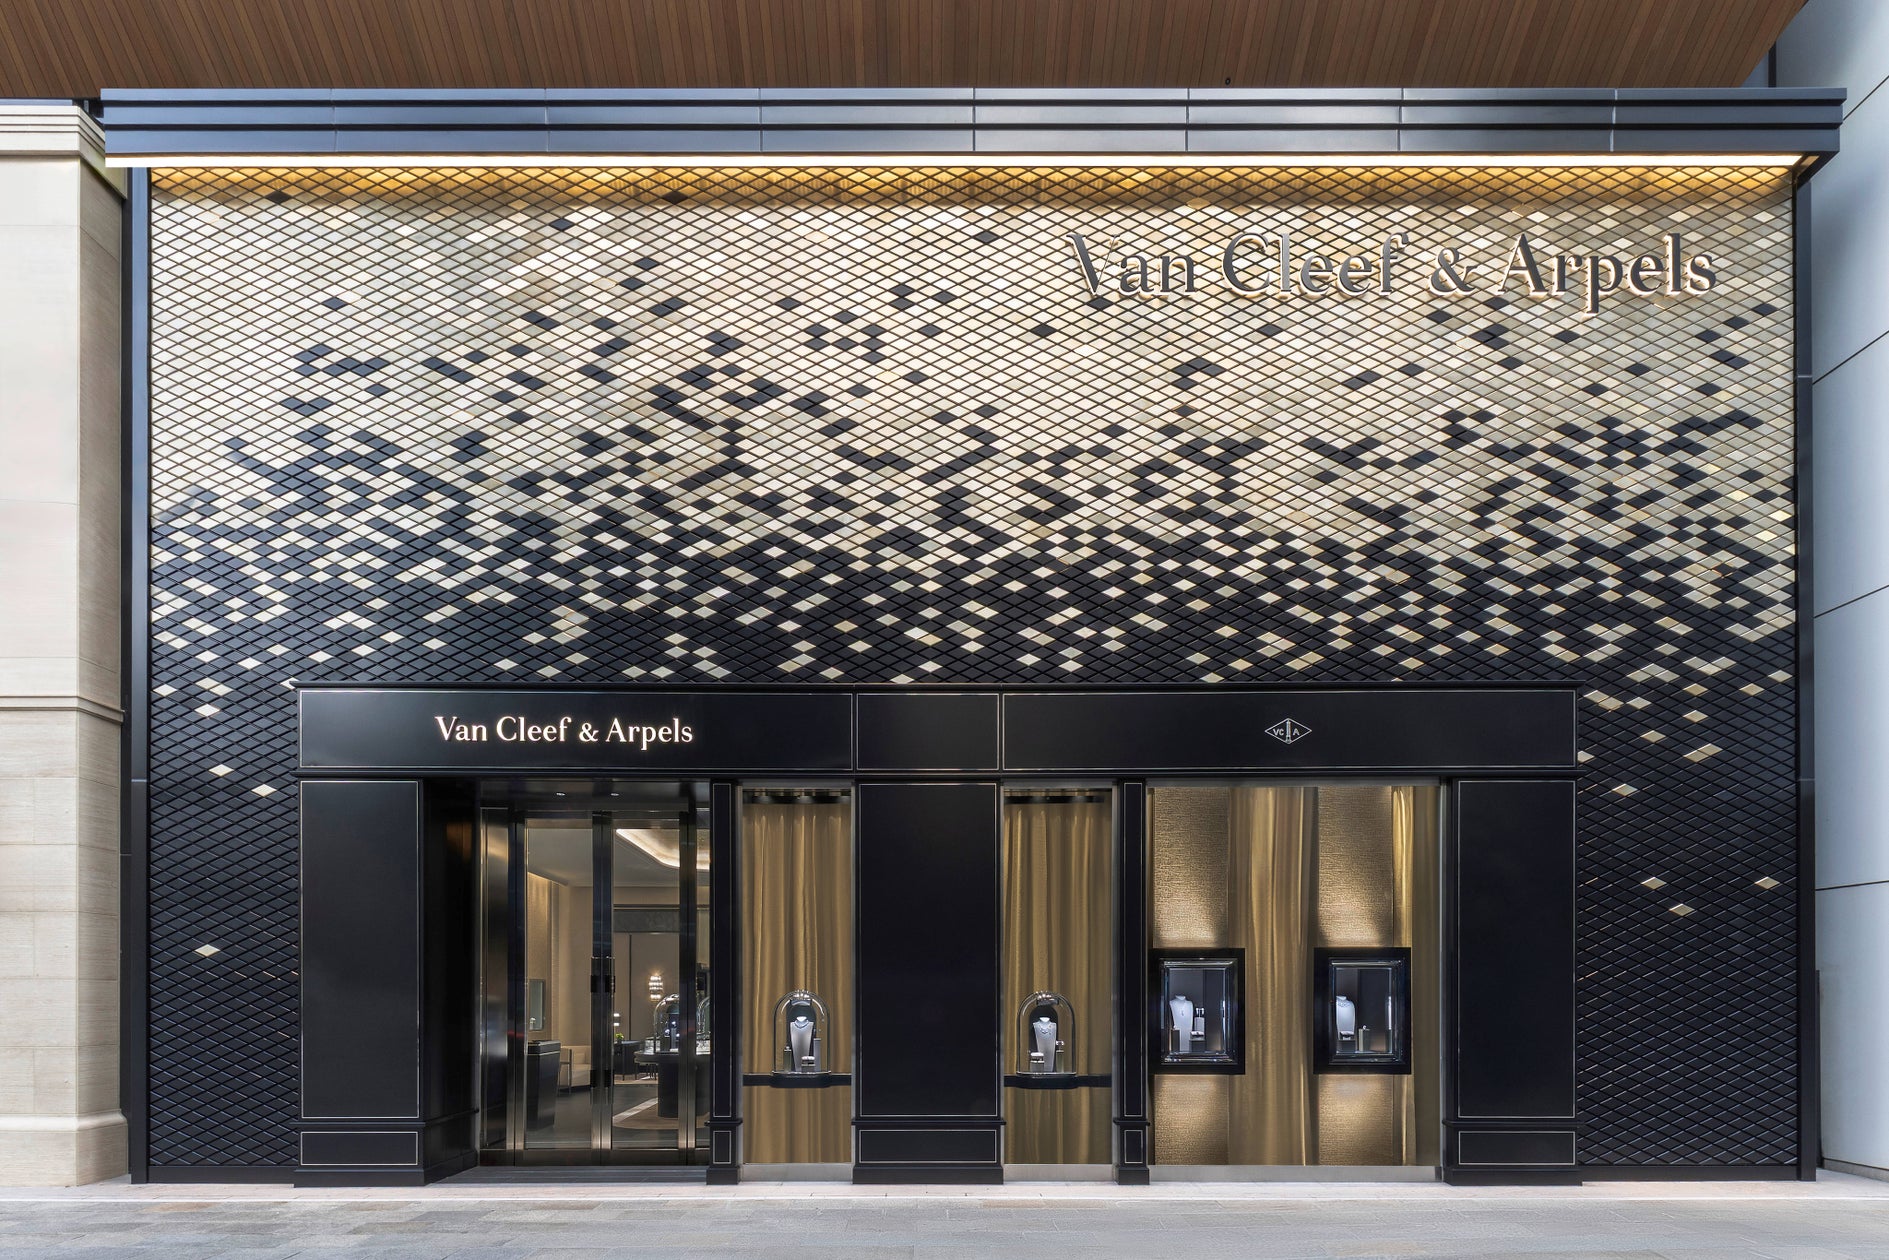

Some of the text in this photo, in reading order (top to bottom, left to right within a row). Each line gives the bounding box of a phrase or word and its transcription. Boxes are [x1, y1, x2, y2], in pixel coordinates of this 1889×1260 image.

[1066, 231, 1718, 317] Van Cleef & Arpels
[434, 716, 693, 750] Van Cleef & Arpels
